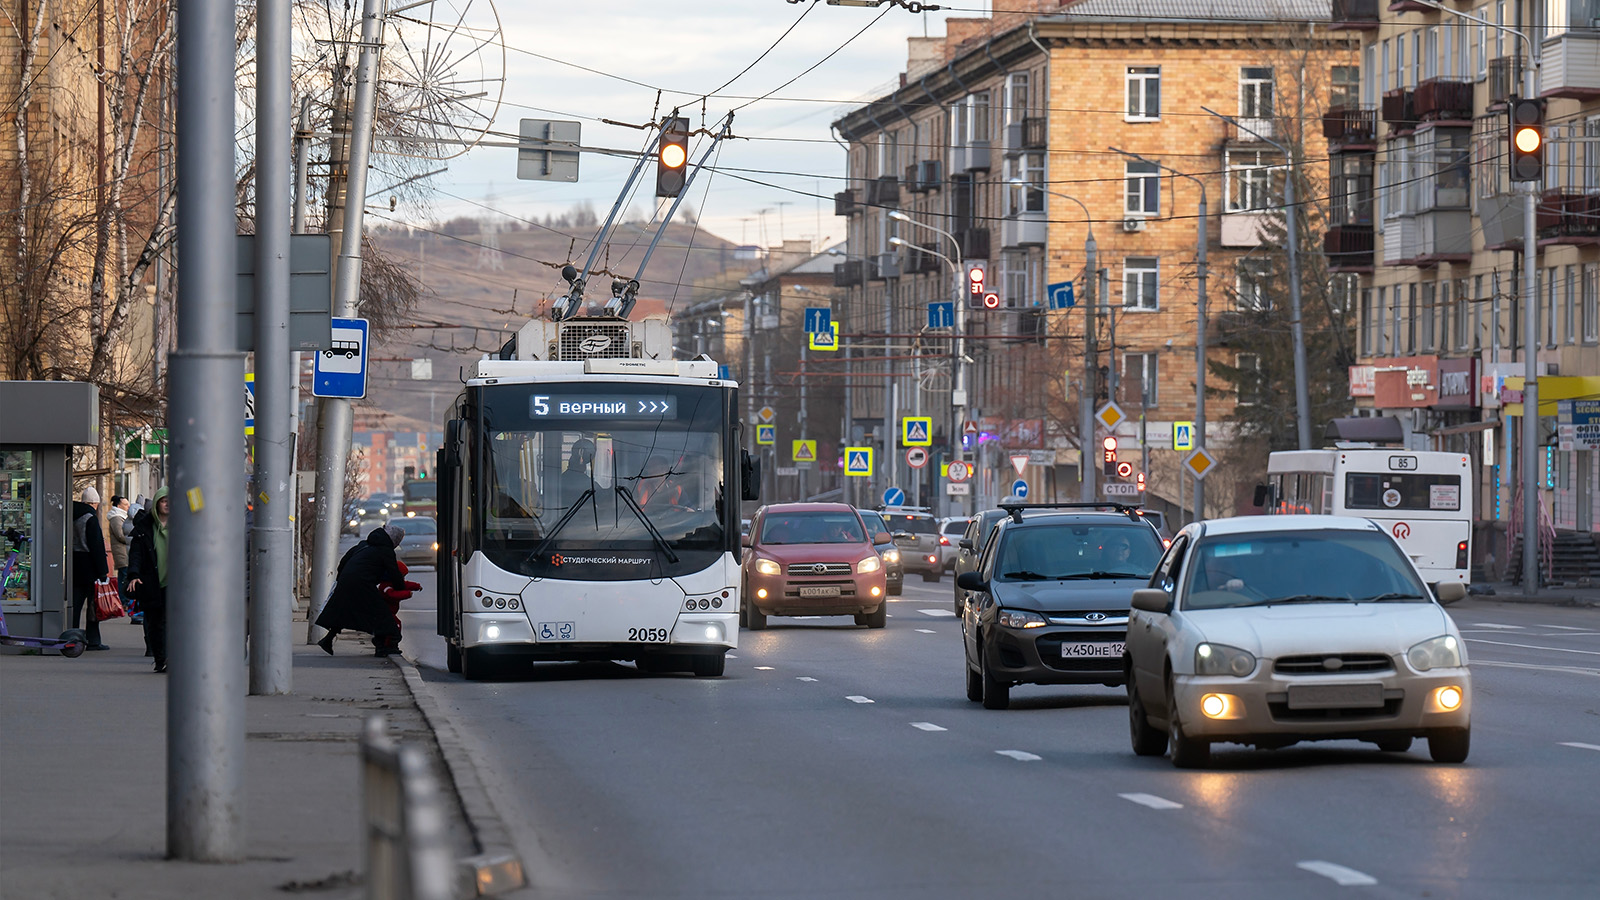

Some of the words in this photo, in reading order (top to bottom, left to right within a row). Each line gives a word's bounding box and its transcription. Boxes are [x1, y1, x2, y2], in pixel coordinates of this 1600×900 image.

[534, 396, 550, 415] 5
[1397, 458, 1409, 468] 85
[1106, 485, 1135, 494] СТОП
[562, 556, 617, 564] СТУДЕНЧЕСКИЙ
[628, 627, 668, 642] 2059
